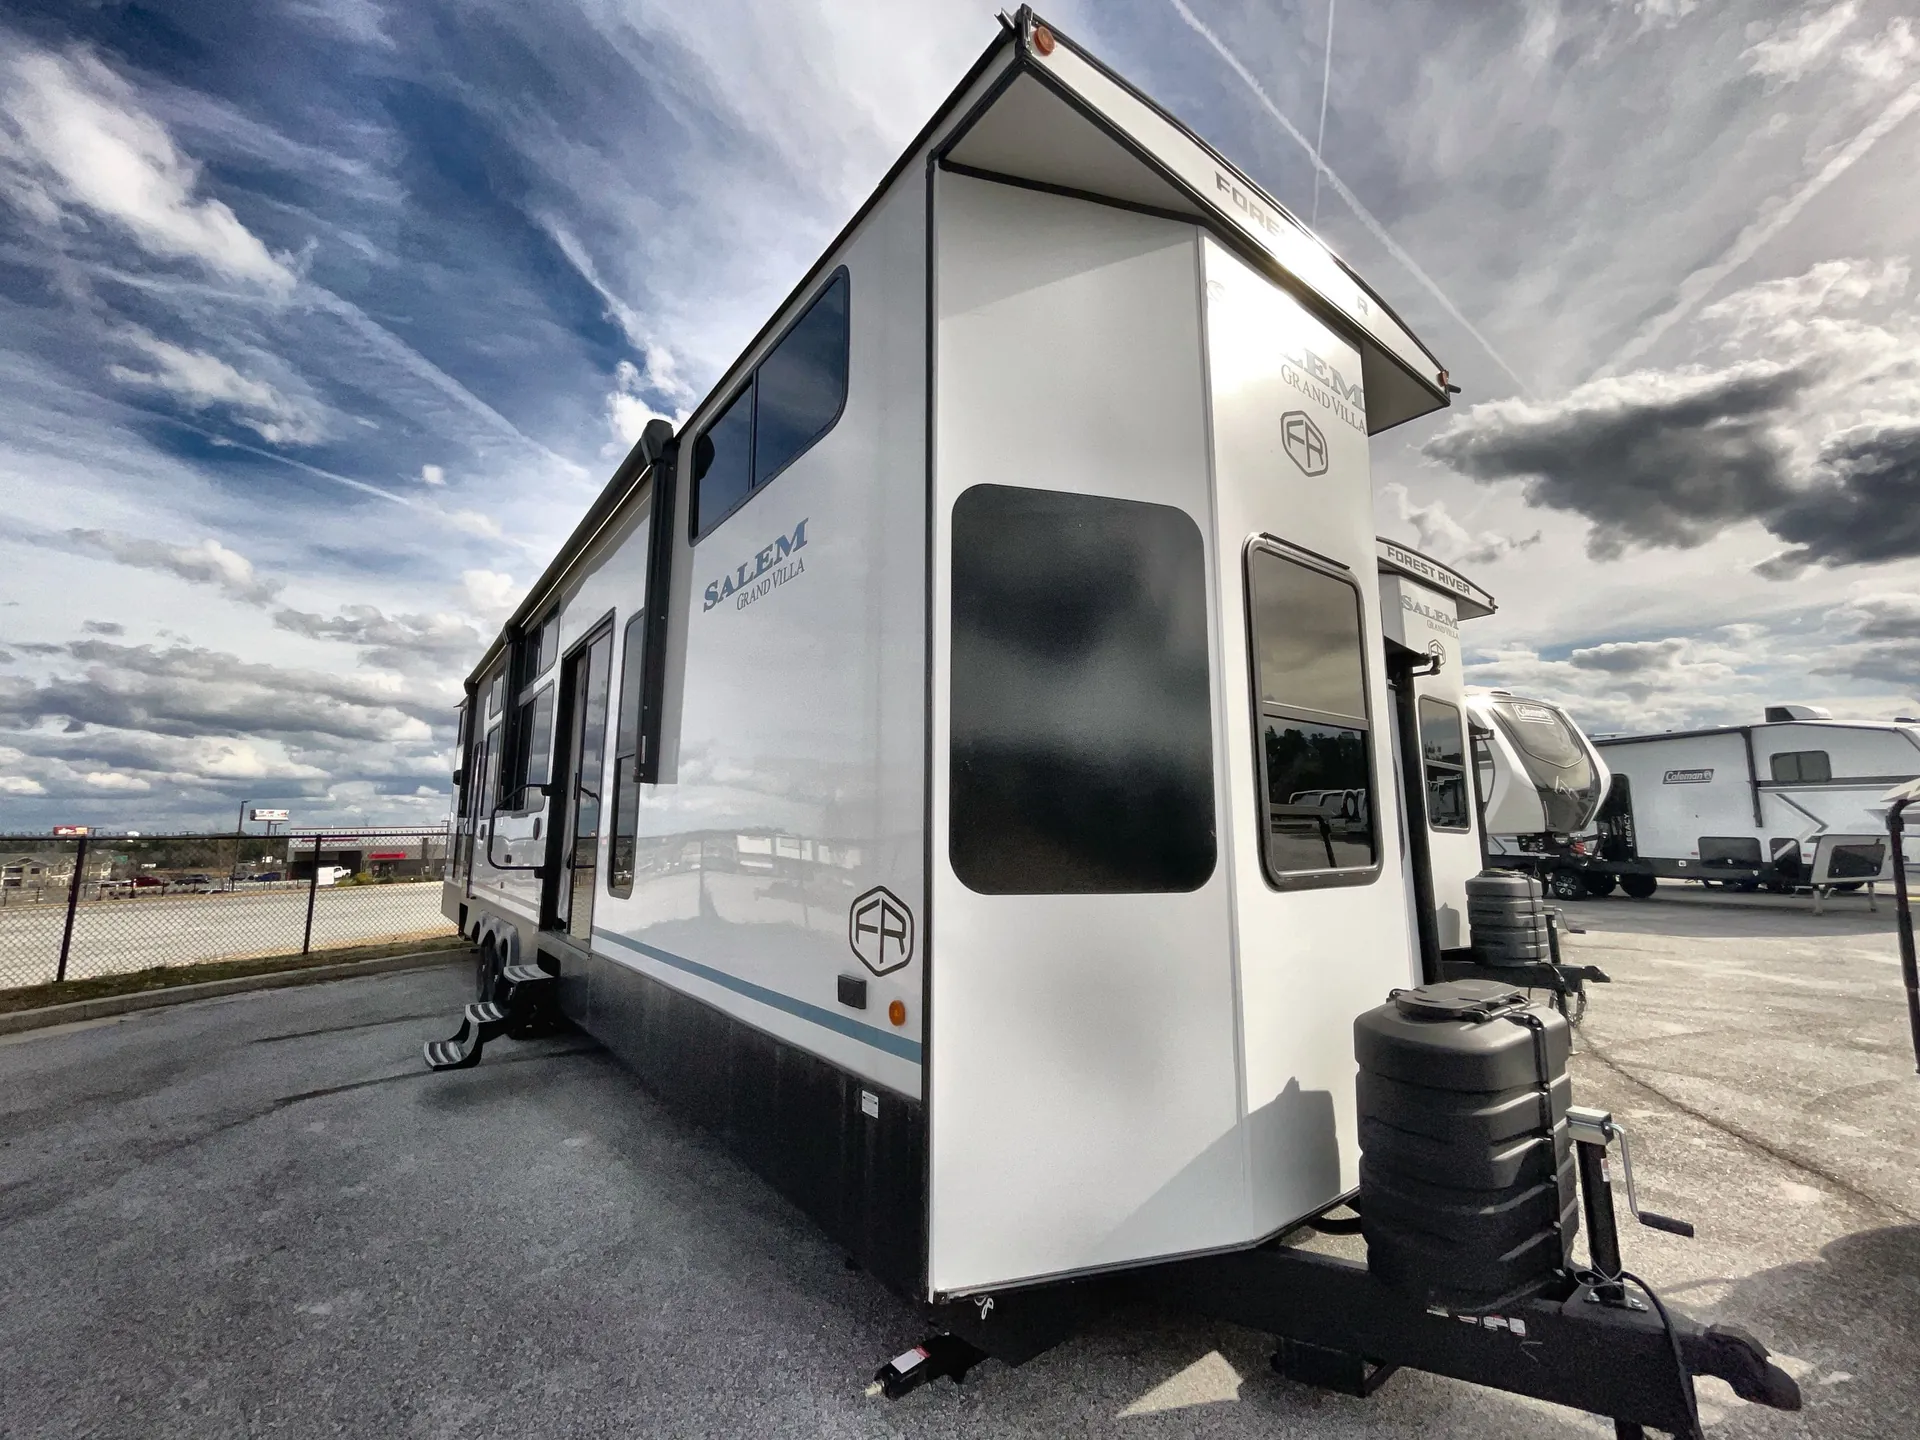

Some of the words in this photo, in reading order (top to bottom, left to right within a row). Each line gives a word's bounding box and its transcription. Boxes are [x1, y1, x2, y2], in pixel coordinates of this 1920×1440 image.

[1215, 171, 1284, 237] FORE
[1281, 364, 1331, 409] GRAND
[1330, 395, 1367, 436] VILLA
[703, 517, 809, 613] SALEM
[736, 579, 771, 611] GRAND
[772, 557, 805, 589] VILLA
[1387, 545, 1436, 579] FOREST
[1438, 570, 1471, 595] RIVER
[1401, 594, 1460, 631] SALEM
[1665, 771, 1704, 781] Coleman
[1623, 813, 1634, 847] LEGACY
